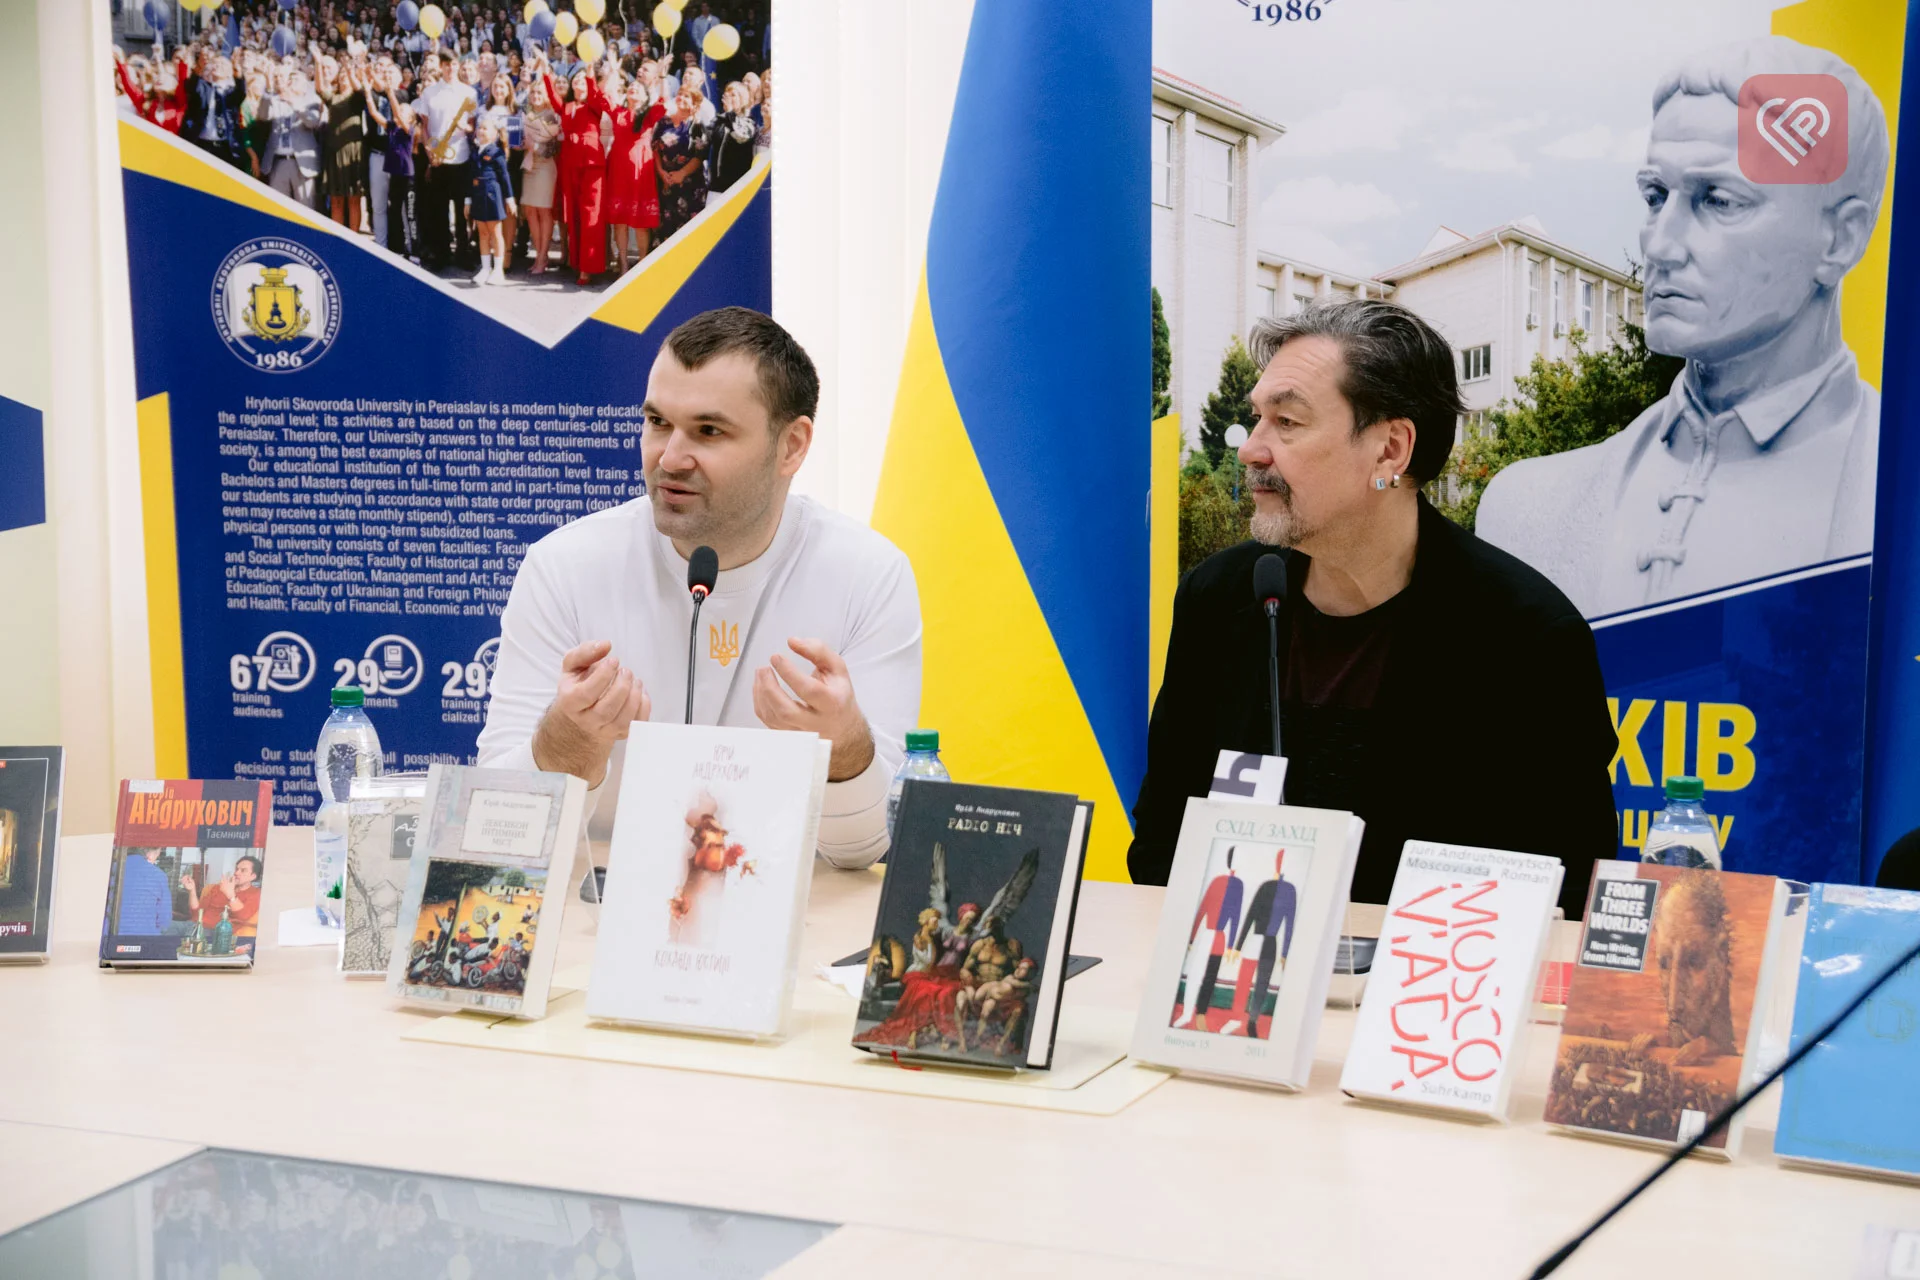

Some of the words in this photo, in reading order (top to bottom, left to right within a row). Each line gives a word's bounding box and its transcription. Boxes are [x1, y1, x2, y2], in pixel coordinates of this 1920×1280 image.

[1251, 0, 1322, 27] 1986
[261, 241, 318, 267] UNIVERSITY
[255, 350, 303, 370] 1986
[245, 395, 290, 413] Hryhorii
[292, 396, 354, 412] Skovoroda
[356, 398, 413, 415] University
[415, 399, 426, 413] in
[428, 399, 488, 414] Pereiaslav
[489, 401, 500, 415] is
[502, 404, 510, 415] a
[512, 401, 556, 416] modern
[558, 402, 594, 419] higher
[218, 410, 236, 425] the
[240, 411, 285, 428] regional
[289, 412, 319, 429] level;
[324, 413, 339, 427] its
[342, 413, 394, 428] activities
[397, 417, 416, 429] are
[420, 415, 454, 430] based
[458, 419, 474, 430] on
[478, 416, 497, 431] the
[501, 417, 530, 434] deep
[534, 418, 609, 433] centuries-old
[219, 426, 277, 442] Pereiaslav.
[282, 428, 340, 446] Therefore,
[345, 432, 364, 444] our
[368, 430, 425, 448] University
[428, 434, 477, 446] answers
[480, 432, 493, 447] to
[496, 433, 516, 447] the
[519, 433, 540, 448] last
[544, 434, 619, 452] requirements
[623, 436, 636, 450] of
[220, 441, 262, 459] society,
[264, 442, 275, 457] is
[277, 446, 317, 460] among
[320, 444, 338, 458] the
[341, 444, 366, 459] best
[368, 445, 423, 462] examples
[425, 446, 437, 460] of
[439, 446, 485, 461] national
[488, 447, 525, 465] higher
[528, 448, 586, 464] education.
[248, 458, 268, 472] Our
[274, 459, 339, 474] educational
[344, 460, 401, 475] institution
[406, 462, 418, 476] of
[422, 462, 440, 476] the
[445, 462, 481, 477] fourth
[486, 463, 560, 479] accreditation
[564, 465, 591, 480] level
[595, 466, 629, 481] trains
[221, 473, 275, 488] Bachelors
[277, 474, 299, 489] and
[301, 475, 348, 490] Masters
[350, 476, 396, 493] degrees
[397, 477, 408, 491] in
[410, 477, 458, 492] full-time
[460, 478, 488, 493] form
[490, 479, 512, 493] and
[515, 479, 526, 494] in
[528, 480, 581, 497] part-time
[583, 481, 611, 495] form
[613, 481, 626, 496] of
[222, 491, 240, 503] our
[242, 489, 290, 504] students
[292, 493, 311, 504] are
[313, 490, 362, 508] studying
[364, 492, 376, 506] in
[378, 492, 442, 507] accordance
[444, 493, 469, 508] with
[471, 494, 500, 508] state
[501, 495, 532, 509] order
[534, 498, 584, 513] program
[222, 506, 248, 518] even
[250, 507, 274, 521] may
[276, 505, 317, 520] receive
[318, 509, 326, 520] a
[328, 506, 356, 521] state
[358, 507, 405, 524] monthly
[406, 508, 456, 526] stipend),
[458, 509, 496, 524] others
[507, 510, 564, 528] according
[224, 519, 268, 537] physical
[270, 524, 316, 538] persons
[319, 525, 331, 536] or
[334, 522, 359, 537] with
[362, 523, 417, 541] long-term
[420, 524, 480, 540] subsidized
[483, 526, 517, 540] loans.
[252, 536, 272, 550] The
[277, 536, 332, 554] university
[336, 537, 384, 552] consists
[388, 539, 400, 553] of
[403, 542, 436, 554] seven
[440, 540, 490, 555] faculties:
[225, 550, 245, 564] and
[248, 550, 282, 565] Social
[285, 551, 363, 570] Technologies;
[367, 553, 407, 571] Faculty
[410, 554, 422, 569] of
[425, 555, 479, 570] Historical
[482, 556, 504, 571] and
[226, 565, 236, 580] of
[239, 566, 306, 584] Pedagogical
[309, 567, 368, 585] Education,
[371, 569, 443, 587] Management
[446, 571, 467, 585] and
[469, 571, 490, 588] Art;
[230, 653, 272, 691] 67
[334, 658, 379, 695] 29
[441, 661, 487, 698] 29
[232, 691, 271, 706] training
[441, 698, 480, 712] training
[233, 705, 284, 718] audiences
[441, 710, 480, 723] cialized
[261, 747, 281, 761] Our
[234, 761, 286, 775] decisions
[289, 763, 310, 777] and
[128, 792, 253, 830] Андрухович
[206, 828, 250, 839] Таємниця
[1406, 856, 1491, 877] Moscoviada
[1500, 868, 1550, 884] Roman
[1605, 881, 1647, 900] FROM
[1600, 896, 1647, 917] THREE
[1590, 911, 1650, 934] WORLDS
[1605, 952, 1641, 967] Ukraine
[1420, 1081, 1492, 1104] Suhrkamp
